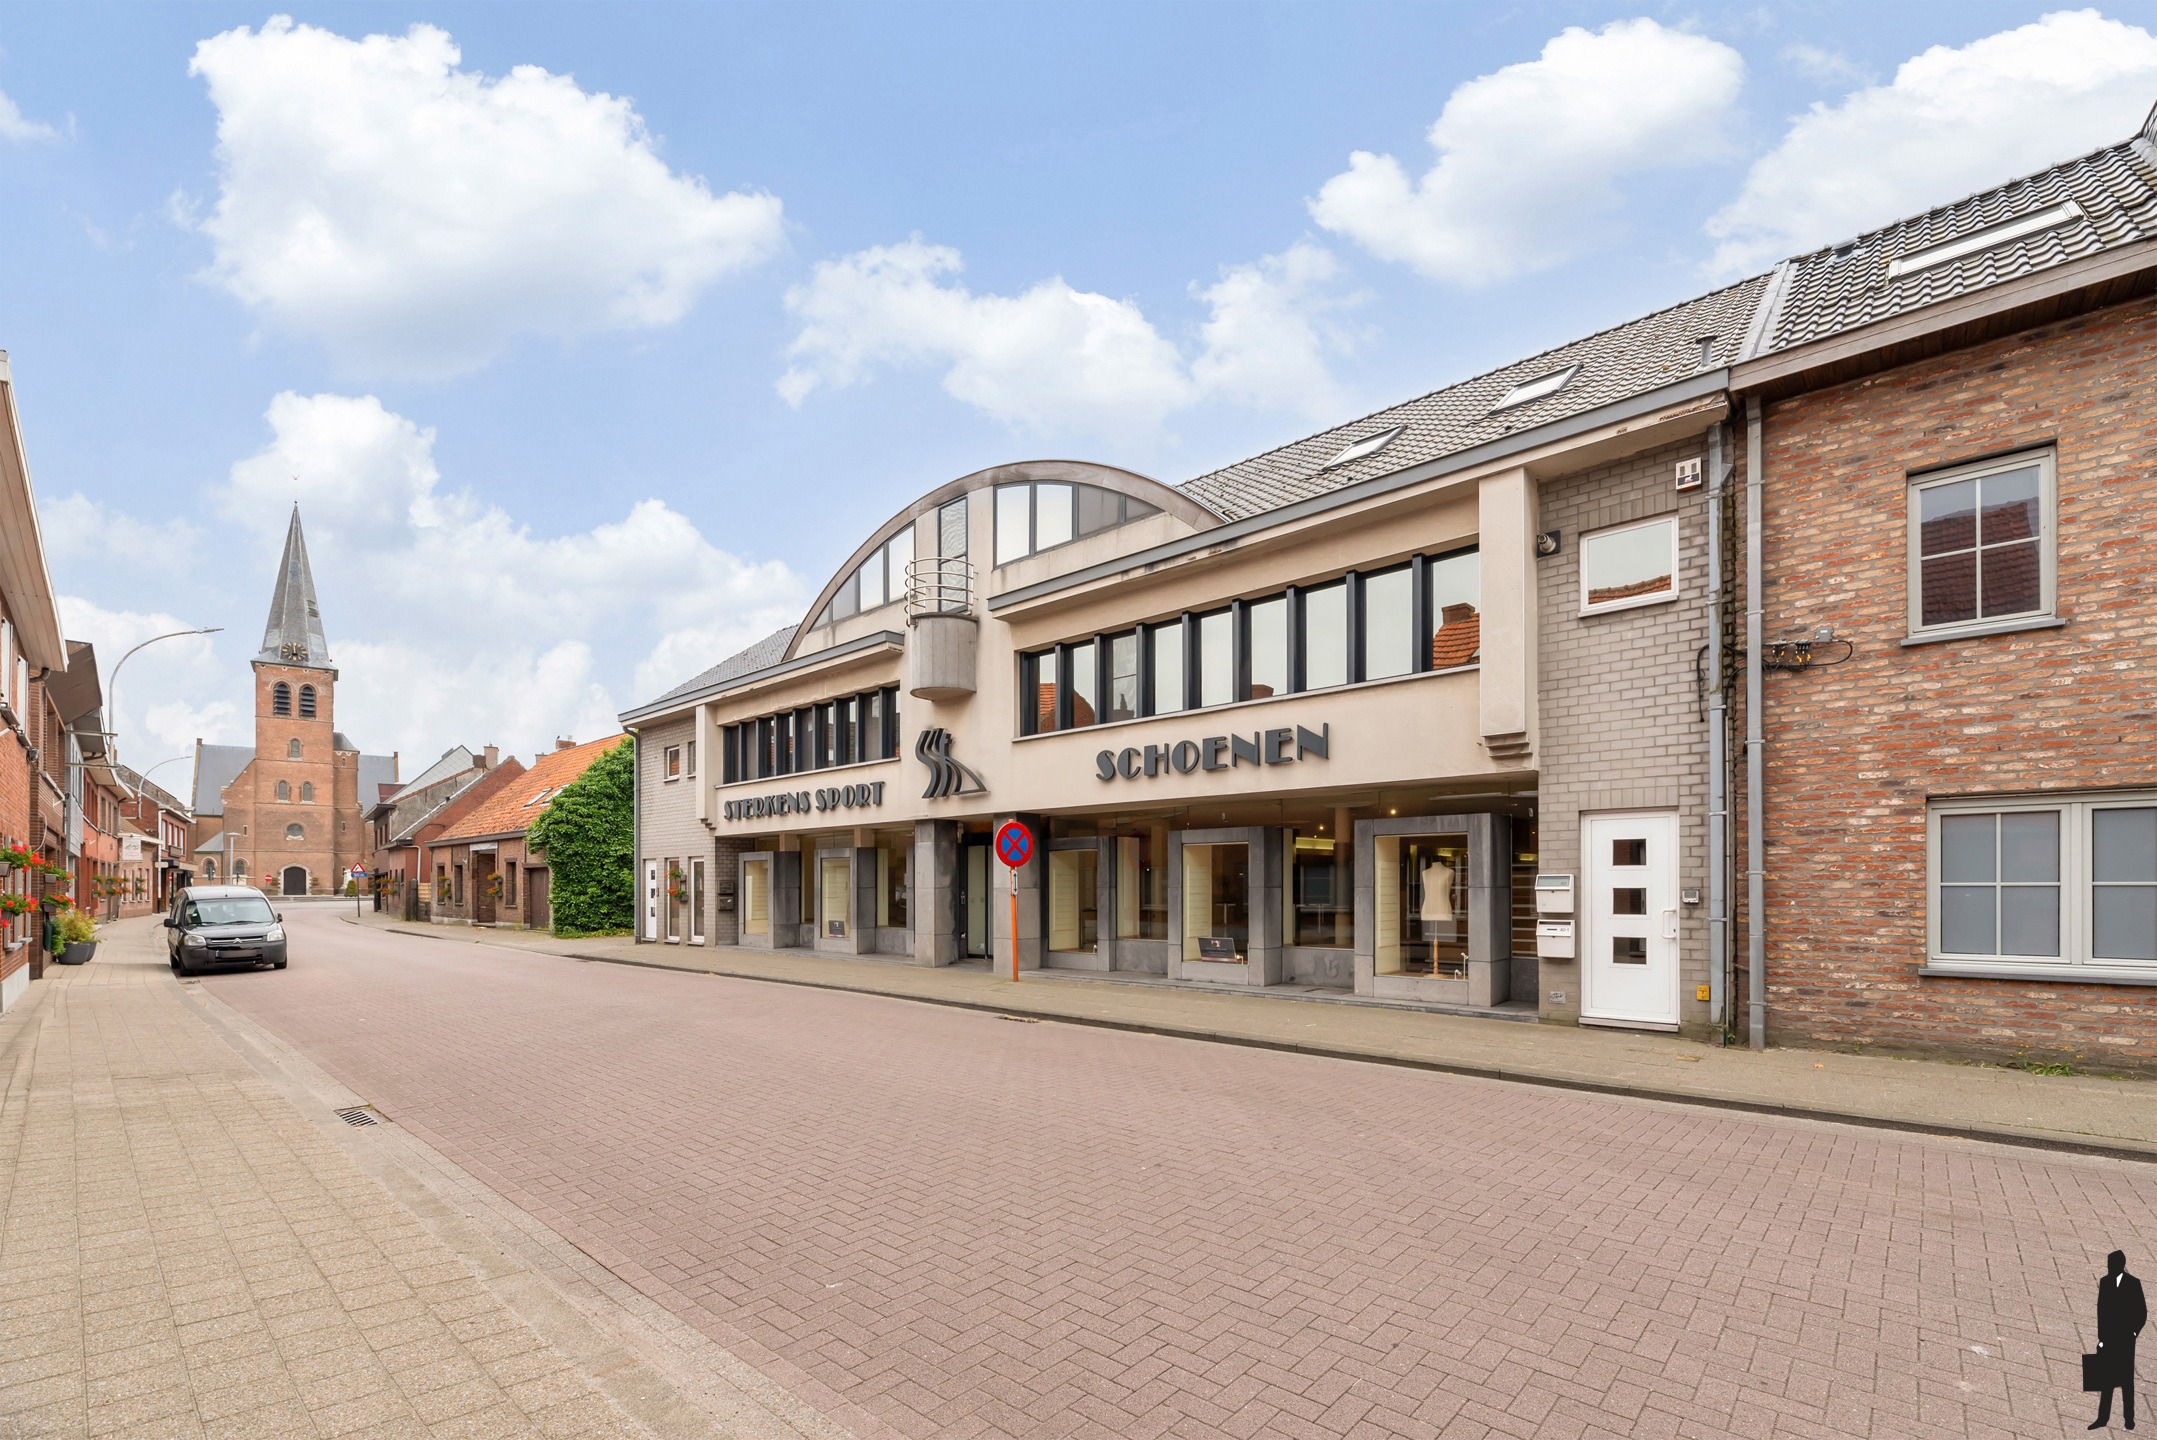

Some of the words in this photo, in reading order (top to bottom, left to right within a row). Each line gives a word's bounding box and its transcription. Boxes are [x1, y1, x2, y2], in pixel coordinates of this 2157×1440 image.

[1095, 722, 1329, 781] SCHOENEN
[724, 790, 812, 821] STERKENS
[815, 781, 885, 812] SPORT
